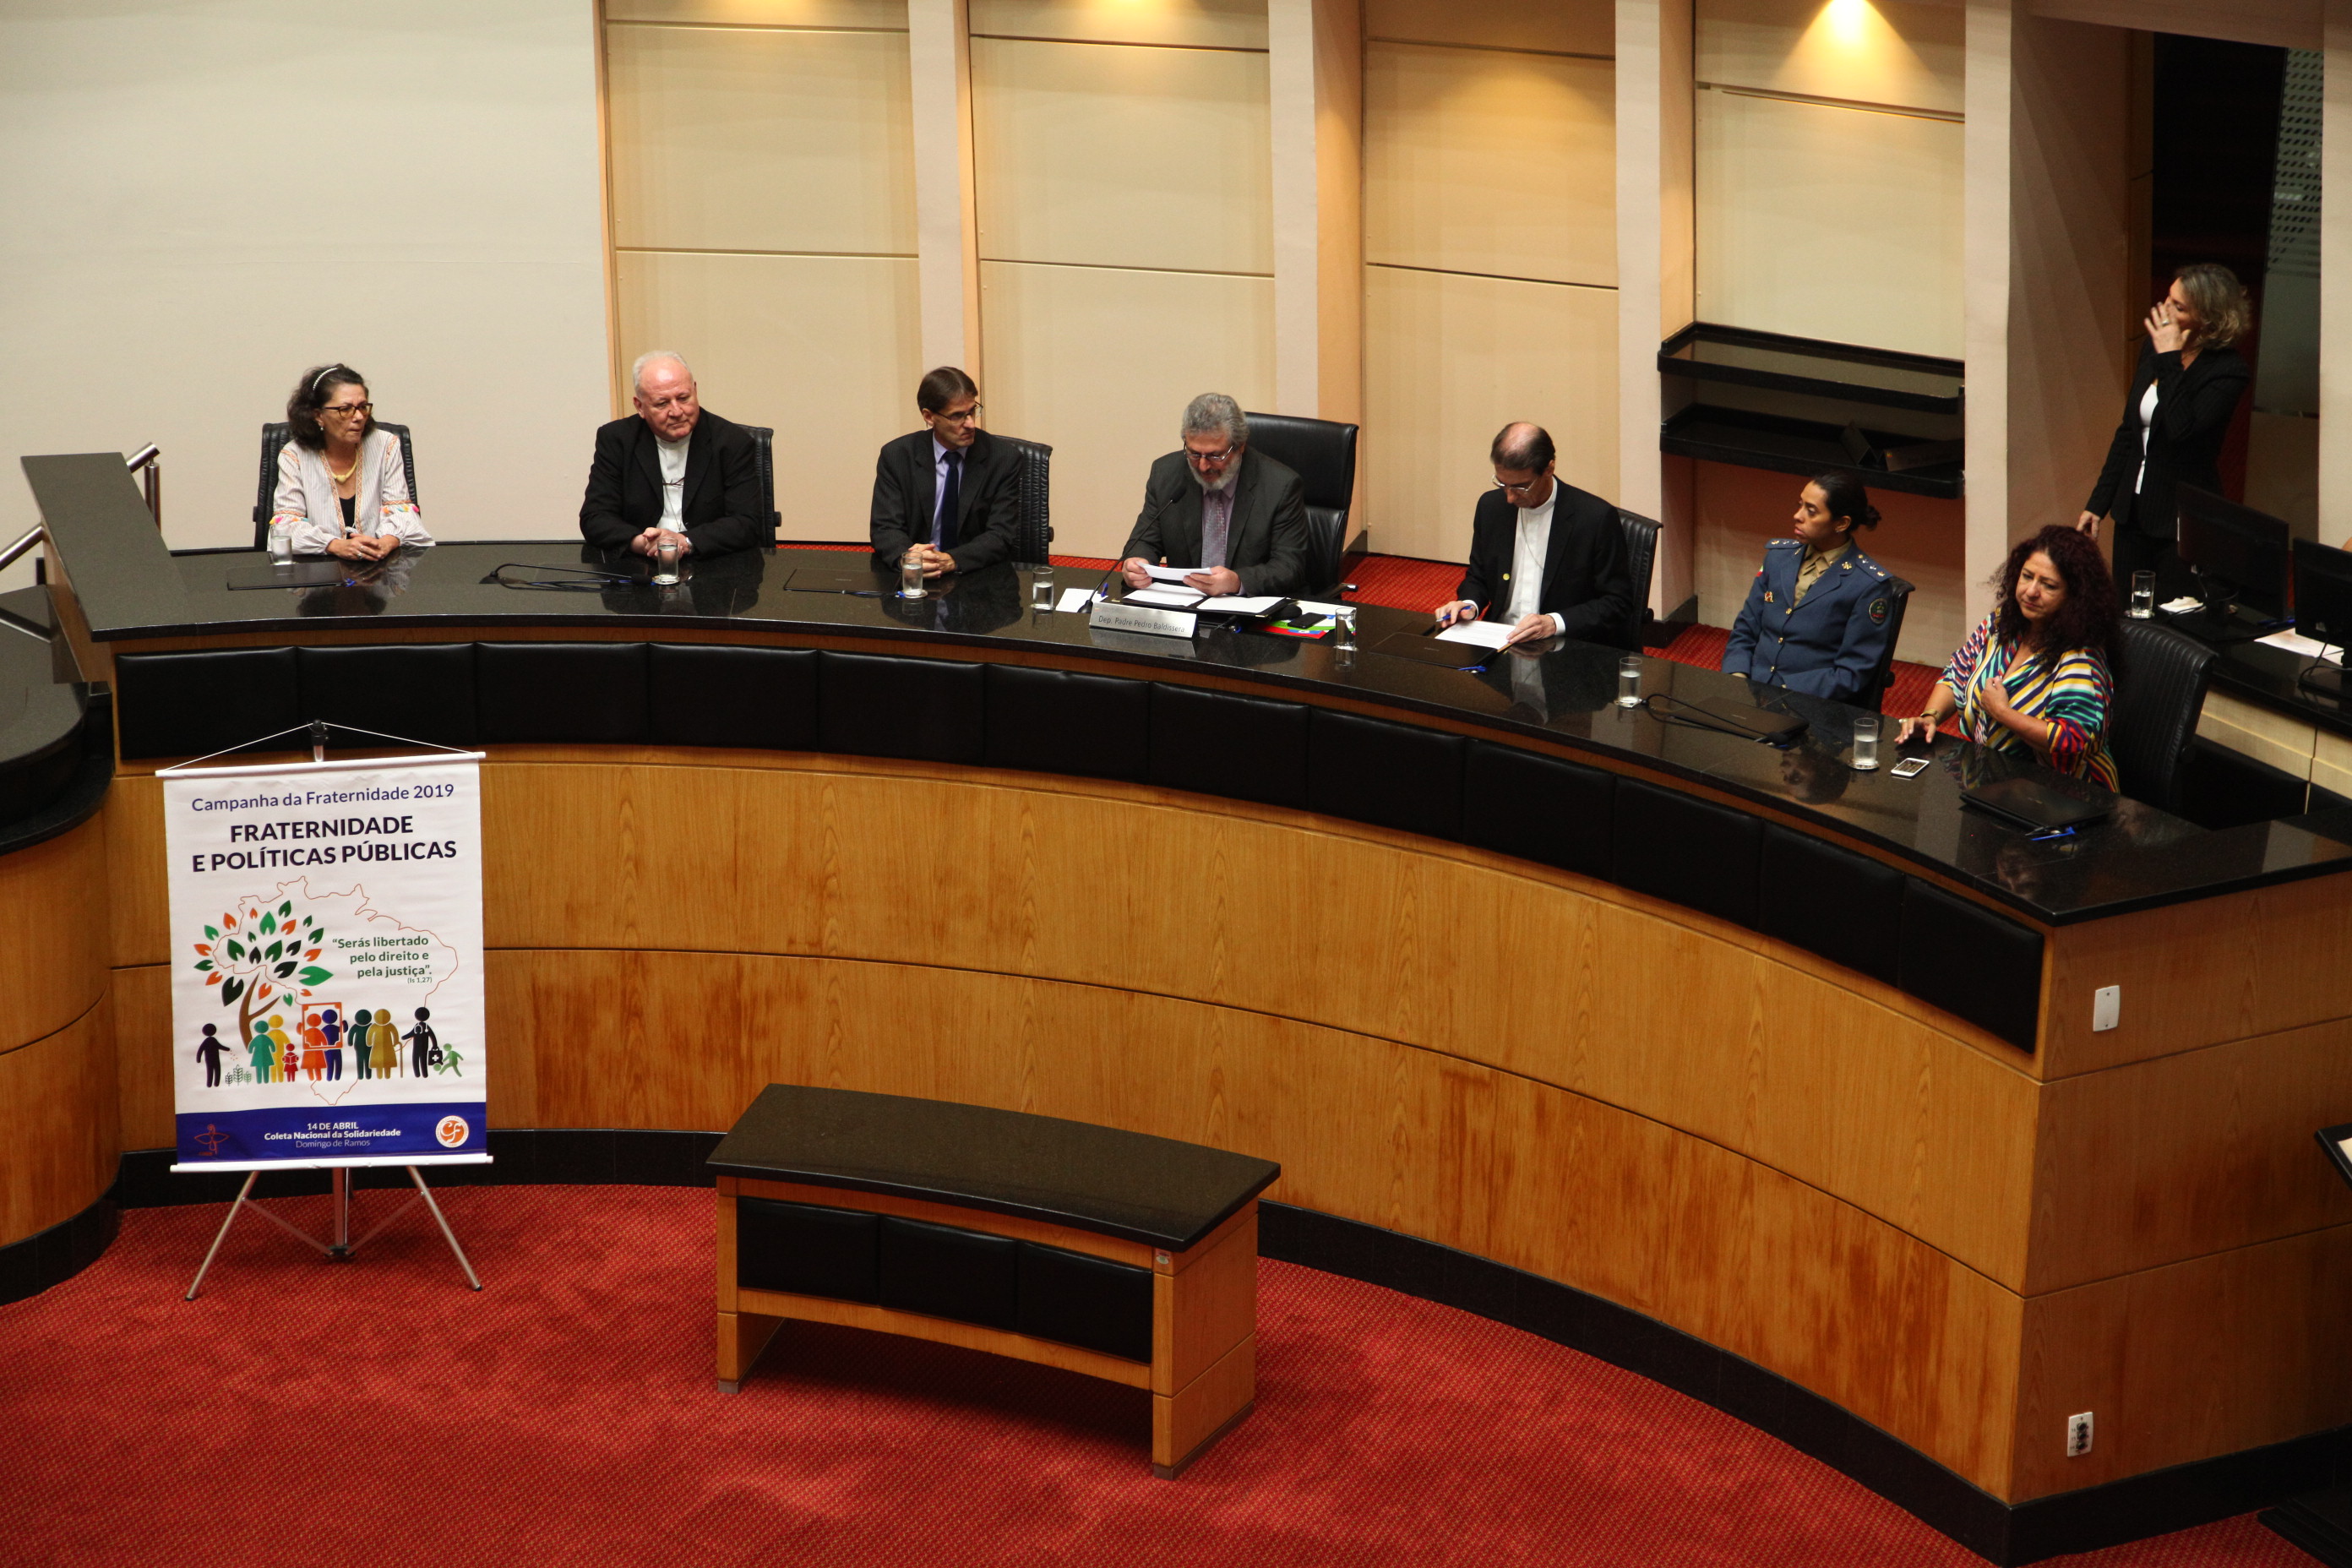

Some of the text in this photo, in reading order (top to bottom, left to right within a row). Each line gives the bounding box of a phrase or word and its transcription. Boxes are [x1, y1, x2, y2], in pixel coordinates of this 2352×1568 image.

[1098, 615, 1185, 633] Dep. Padre Pedro Baldissera
[192, 784, 455, 812] Campanha da Fraternidade 2019
[230, 815, 414, 843] FRATERNIDADE
[192, 840, 457, 873] E POLÍTICAS PÚBLICAS
[373, 935, 429, 947] libertado
[350, 950, 429, 965] pelo direito e
[357, 966, 383, 979] pela
[318, 1122, 331, 1130] DE
[332, 1122, 359, 1130] ABRIL
[264, 1128, 401, 1141] Coleta Nacional da Solidariedade
[296, 1139, 371, 1149] Domingo de Ramos
